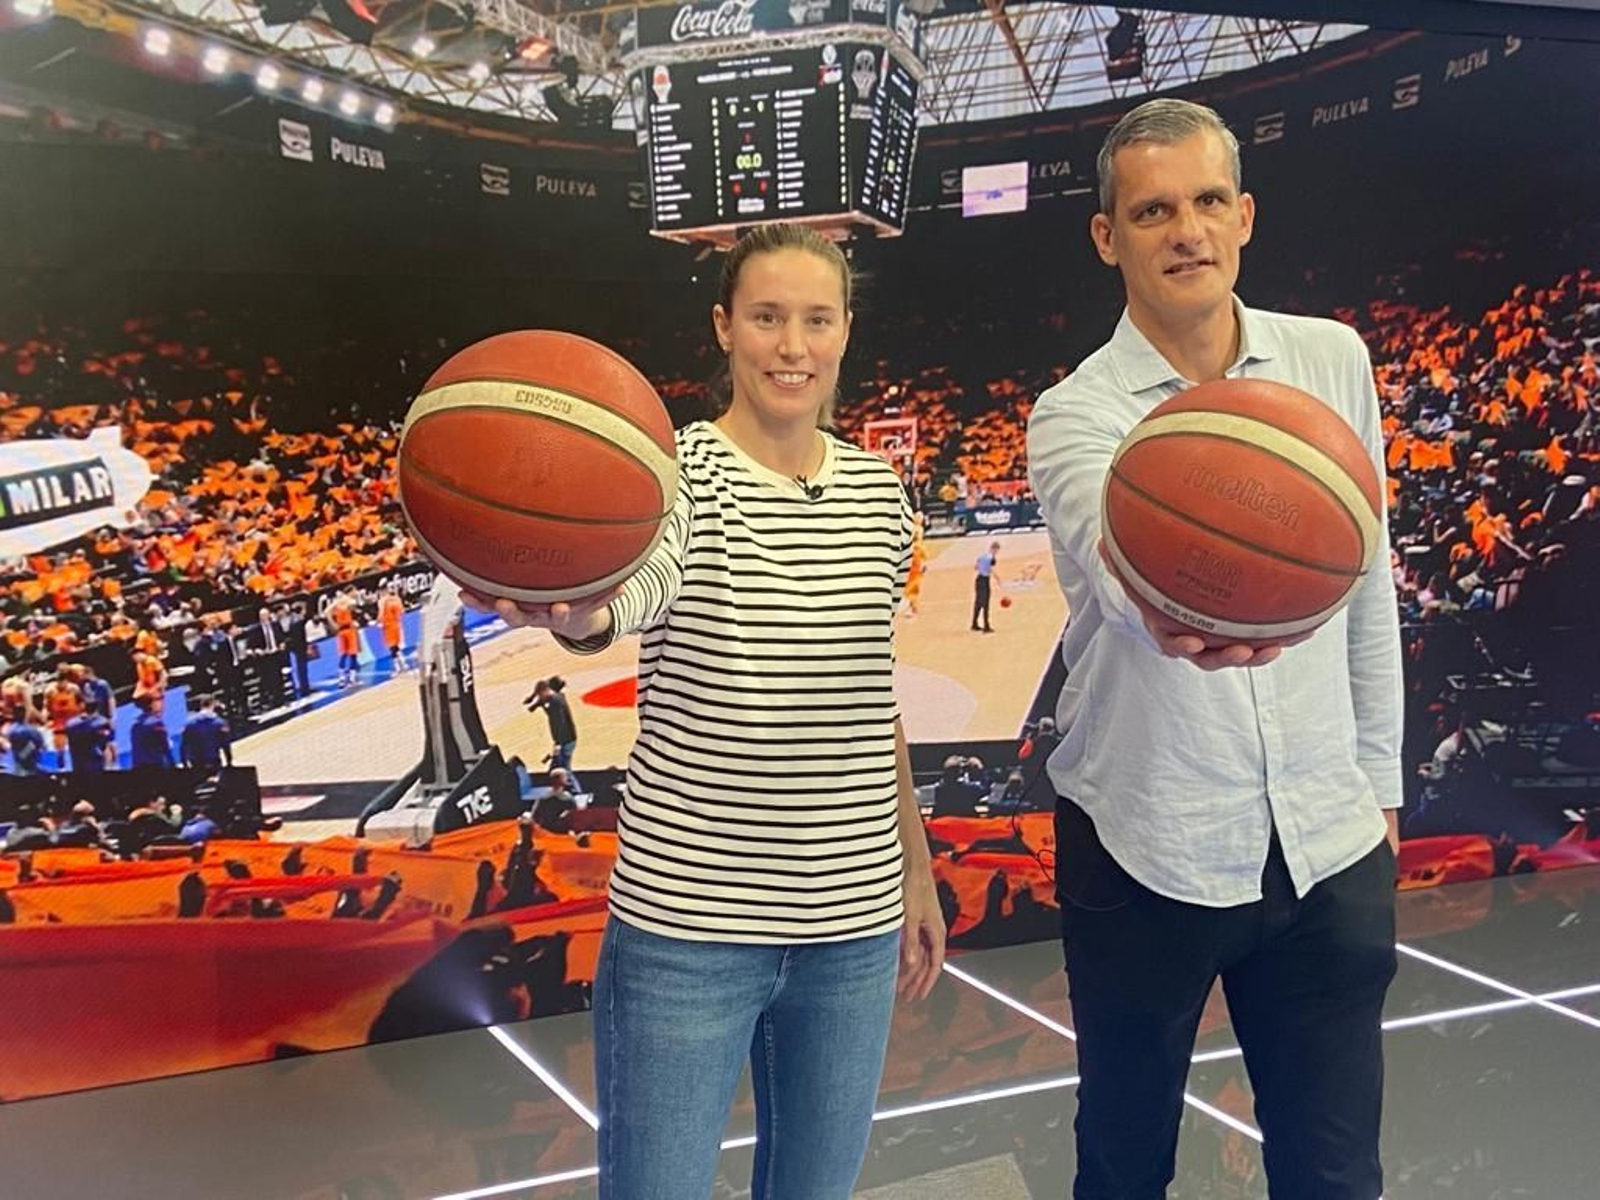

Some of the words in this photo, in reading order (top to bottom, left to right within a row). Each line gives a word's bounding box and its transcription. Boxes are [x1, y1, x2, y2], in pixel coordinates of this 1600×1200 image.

[1312, 97, 1369, 127] PULEVA
[331, 136, 386, 170] PULEVA
[536, 175, 597, 197] PULEVA
[5, 466, 113, 516] MILAR
[1182, 462, 1301, 529] molten
